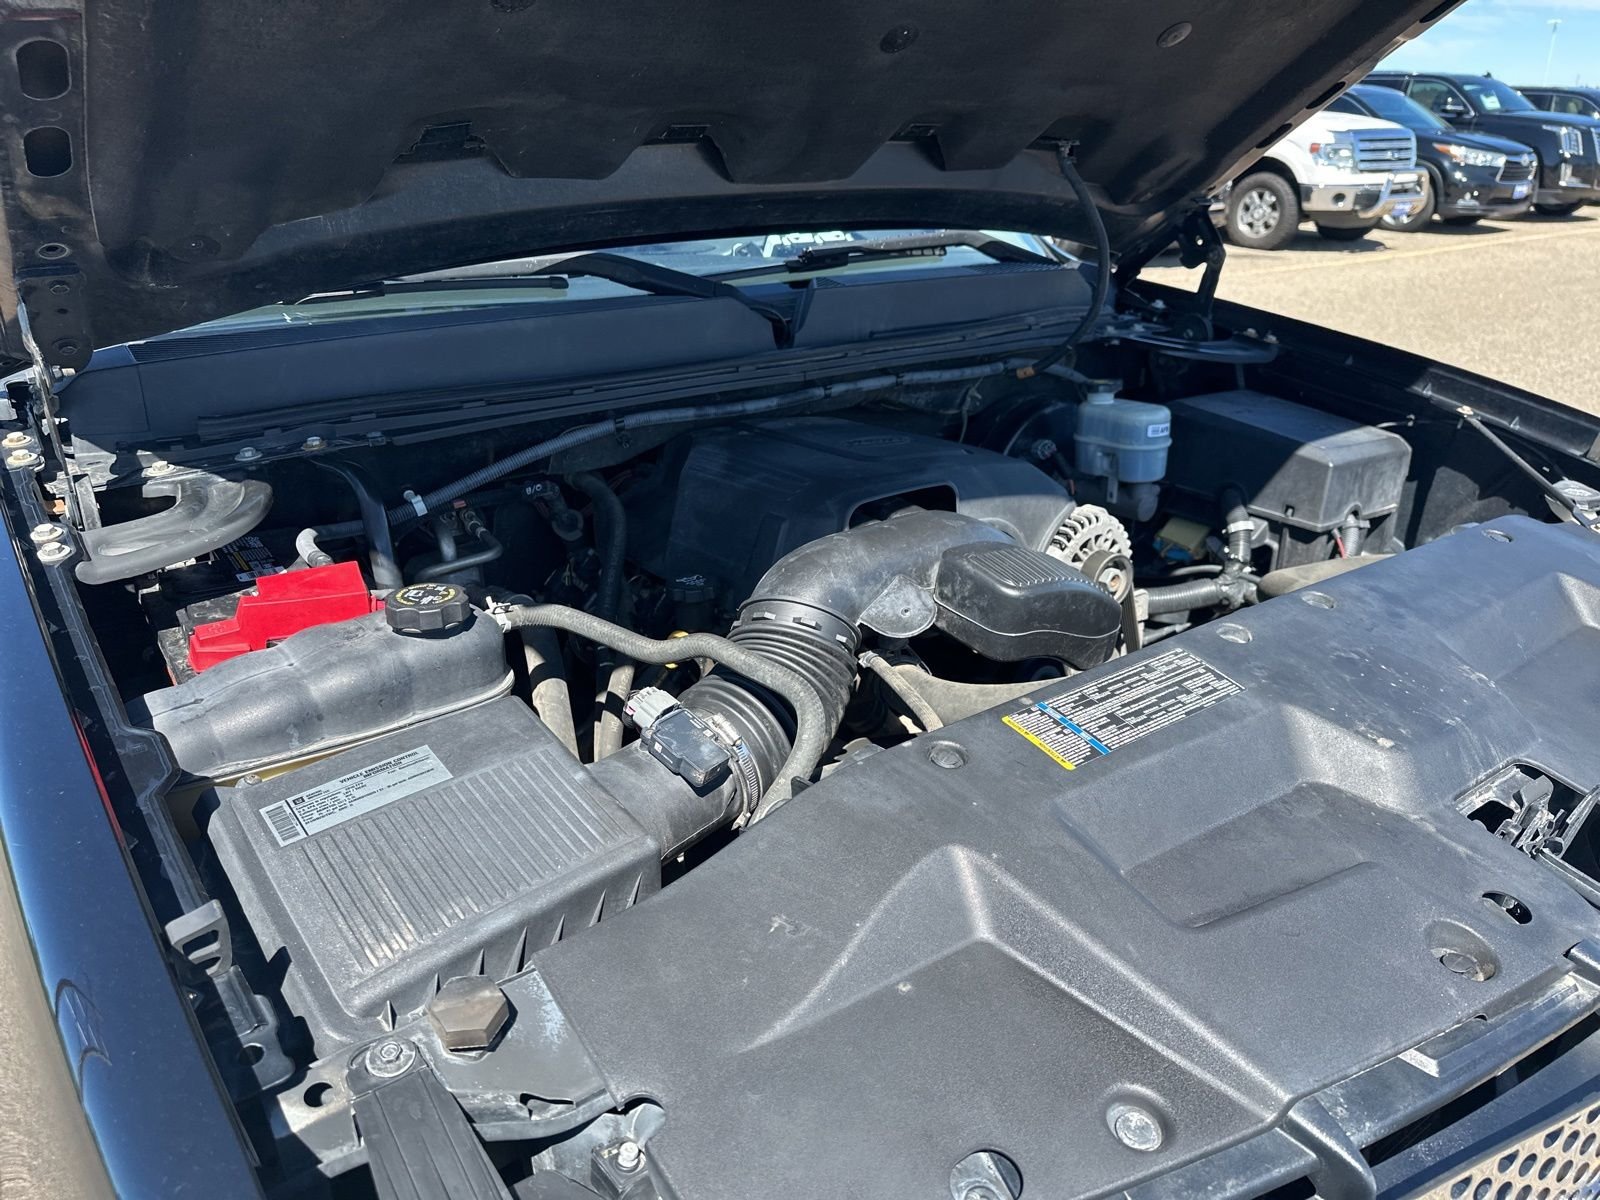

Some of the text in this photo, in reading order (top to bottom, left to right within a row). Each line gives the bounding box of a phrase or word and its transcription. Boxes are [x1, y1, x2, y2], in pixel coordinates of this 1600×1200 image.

[339, 770, 364, 784] VEHICLE
[364, 760, 392, 774] EMISSION
[393, 751, 419, 763] CONTROL
[363, 761, 402, 779] INFORMATION
